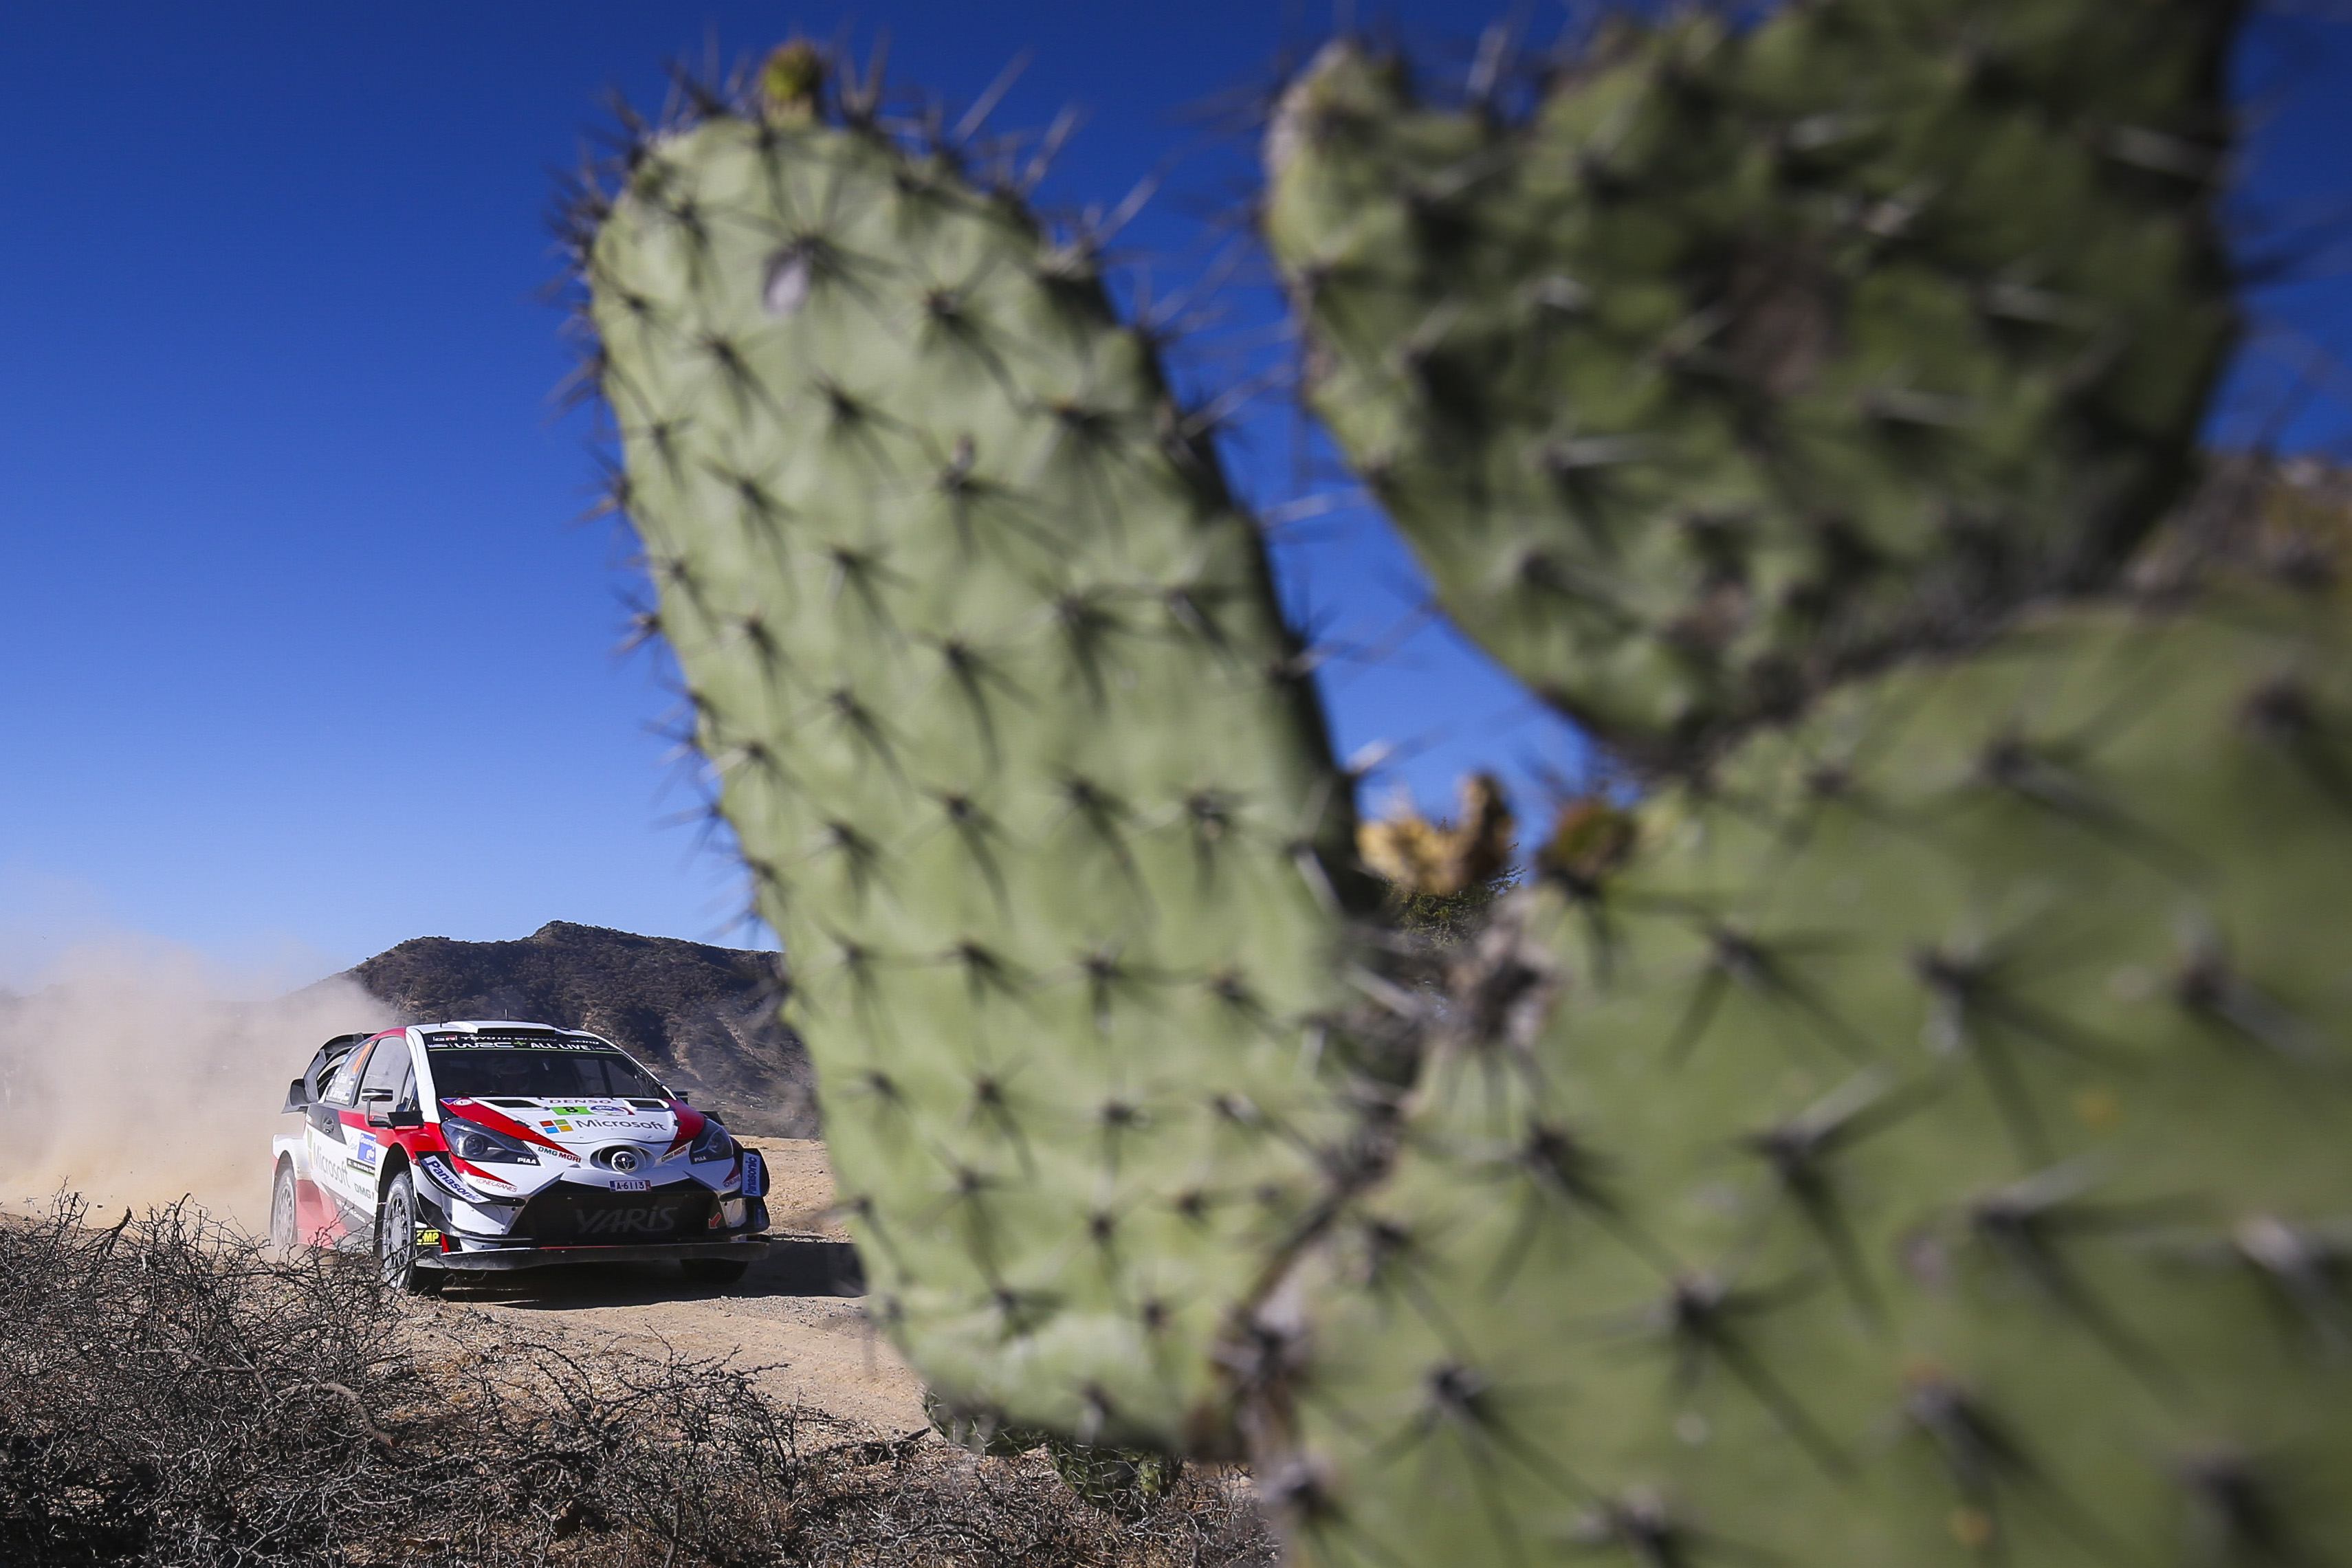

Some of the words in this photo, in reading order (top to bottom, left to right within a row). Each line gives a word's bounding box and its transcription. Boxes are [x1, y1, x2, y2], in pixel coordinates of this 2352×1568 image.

[575, 1119, 668, 1131] Microsoft
[537, 1146, 558, 1157] DMG
[558, 1152, 582, 1163] MORI
[313, 1142, 351, 1189] Microsoft
[426, 1160, 483, 1202] Panasonic
[745, 1156, 758, 1195] Panasonic
[354, 1182, 371, 1200] DMG
[476, 1178, 518, 1193] KONECRANES
